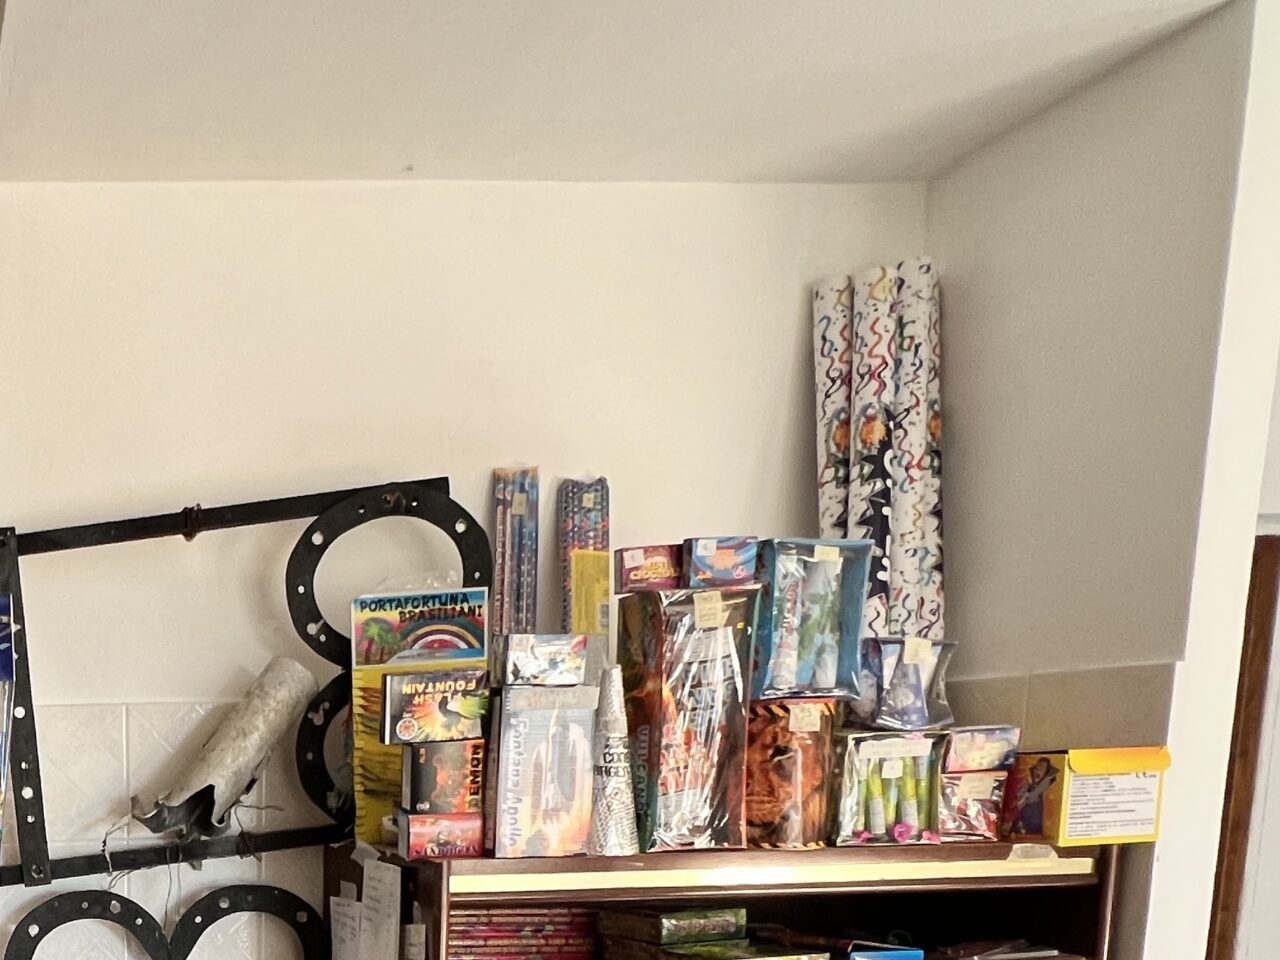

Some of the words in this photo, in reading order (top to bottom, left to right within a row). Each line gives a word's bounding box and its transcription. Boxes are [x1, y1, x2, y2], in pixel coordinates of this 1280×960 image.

[360, 592, 471, 613] PORTAFORTUNA
[398, 604, 483, 624] BRASILIANI
[402, 678, 477, 695] FOUNTAIN
